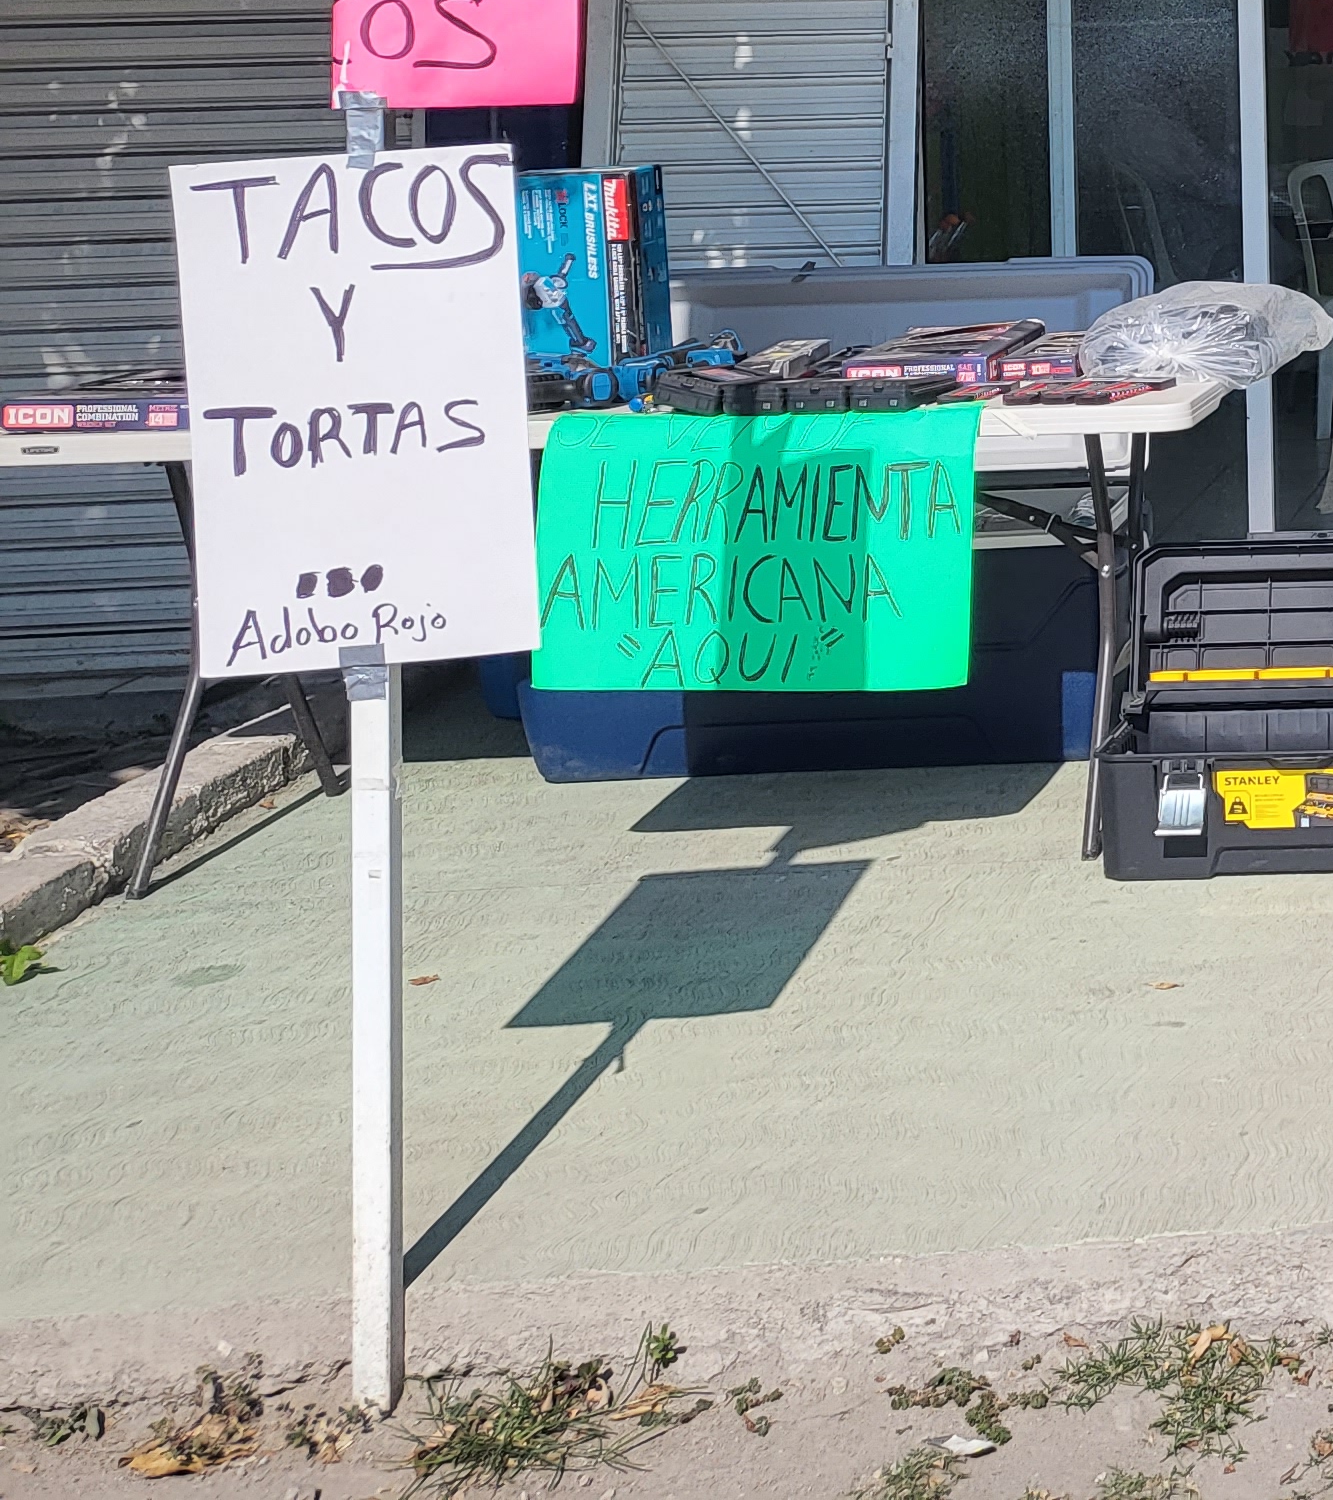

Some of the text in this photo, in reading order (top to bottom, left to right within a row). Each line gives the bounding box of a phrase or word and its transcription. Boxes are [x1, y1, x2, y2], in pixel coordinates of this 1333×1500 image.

[189, 153, 511, 271] TACOS
[584, 212, 599, 280] BRUSHLESS
[309, 283, 356, 363] Y
[904, 364, 956, 373] PROFESSIONAL
[1003, 363, 1026, 371] ICON
[7, 407, 70, 426] ICON
[76, 405, 138, 413] PROFESSIONAL
[76, 413, 139, 421] COMBINATION
[203, 399, 486, 478] TORTAS
[592, 458, 962, 550] HERRAMIENTA
[539, 553, 903, 631] AMERICANA
[226, 602, 447, 667] Adobo Rojo
[1224, 775, 1281, 786] STANLEY
